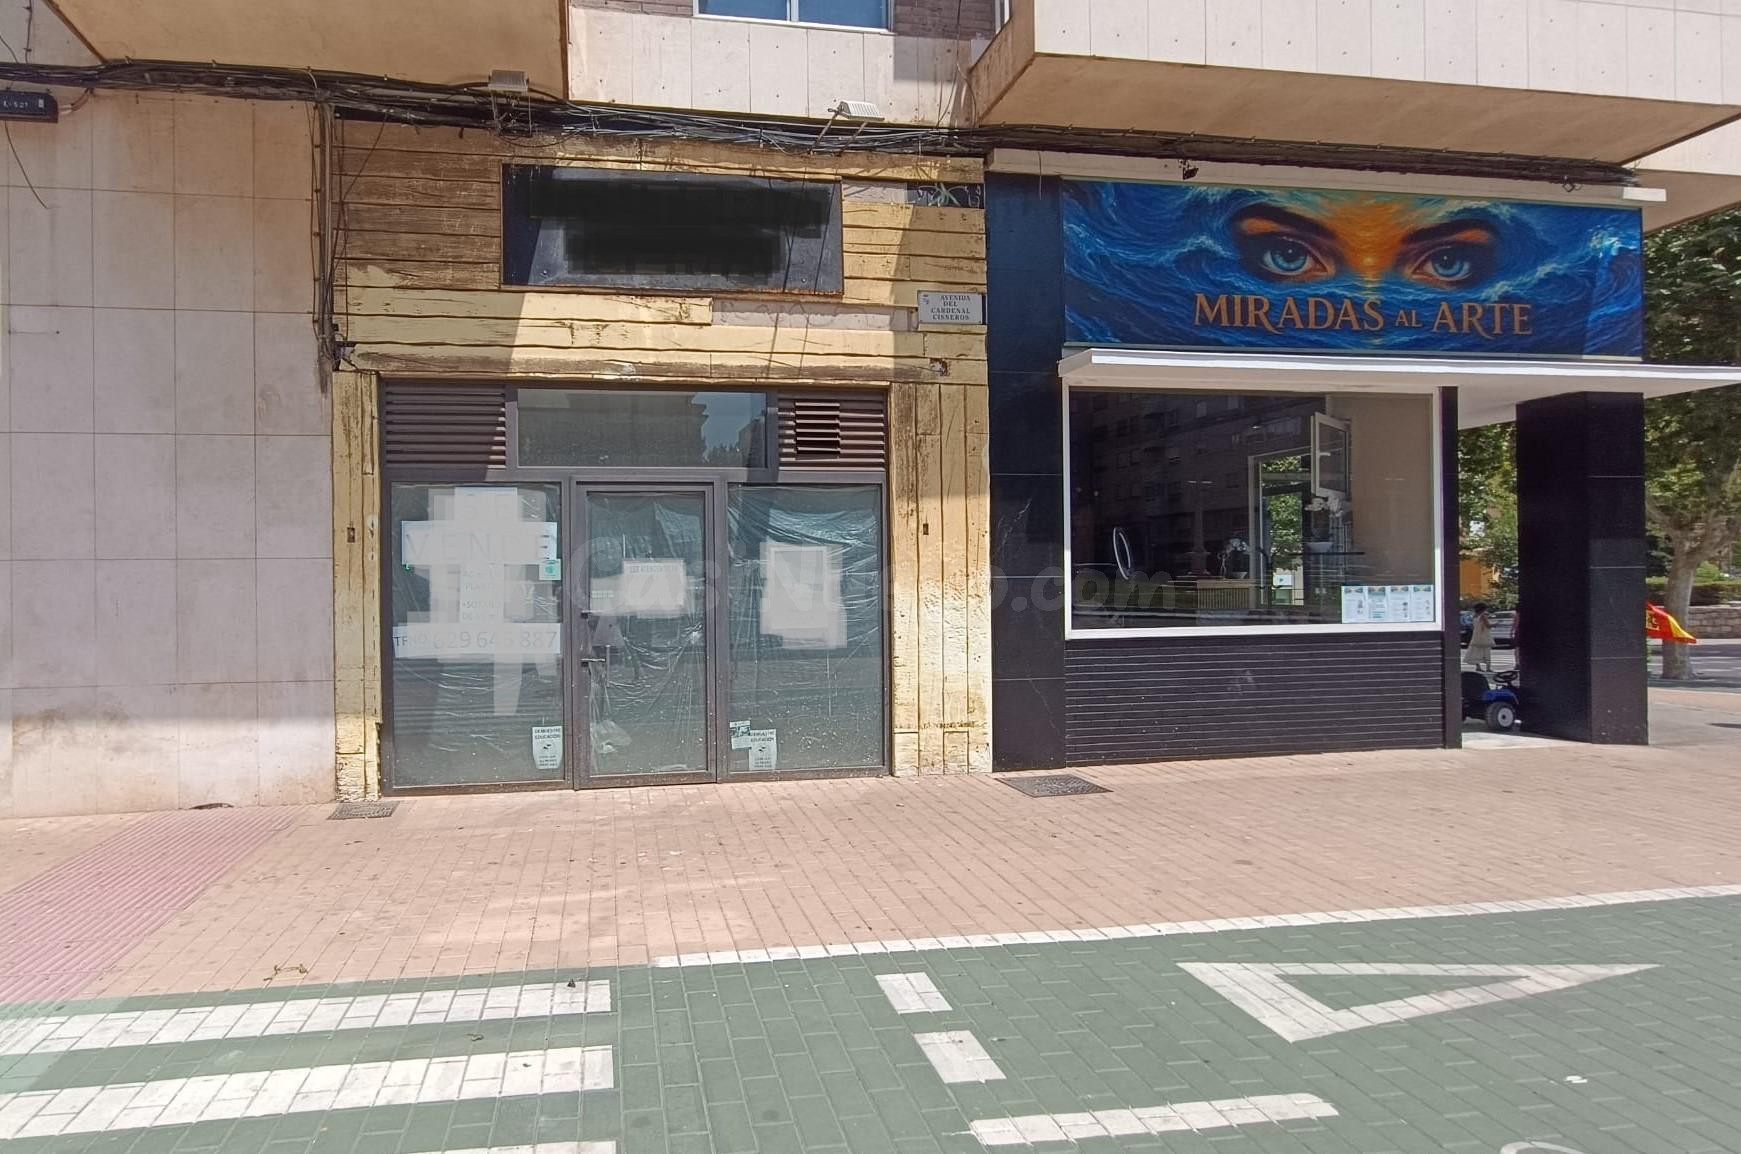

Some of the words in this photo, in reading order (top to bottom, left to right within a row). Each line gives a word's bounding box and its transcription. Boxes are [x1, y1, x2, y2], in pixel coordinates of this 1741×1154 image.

[1194, 293, 1385, 334] MIRADAS
[1395, 309, 1422, 328] AL
[1433, 302, 1532, 339] ARTE
